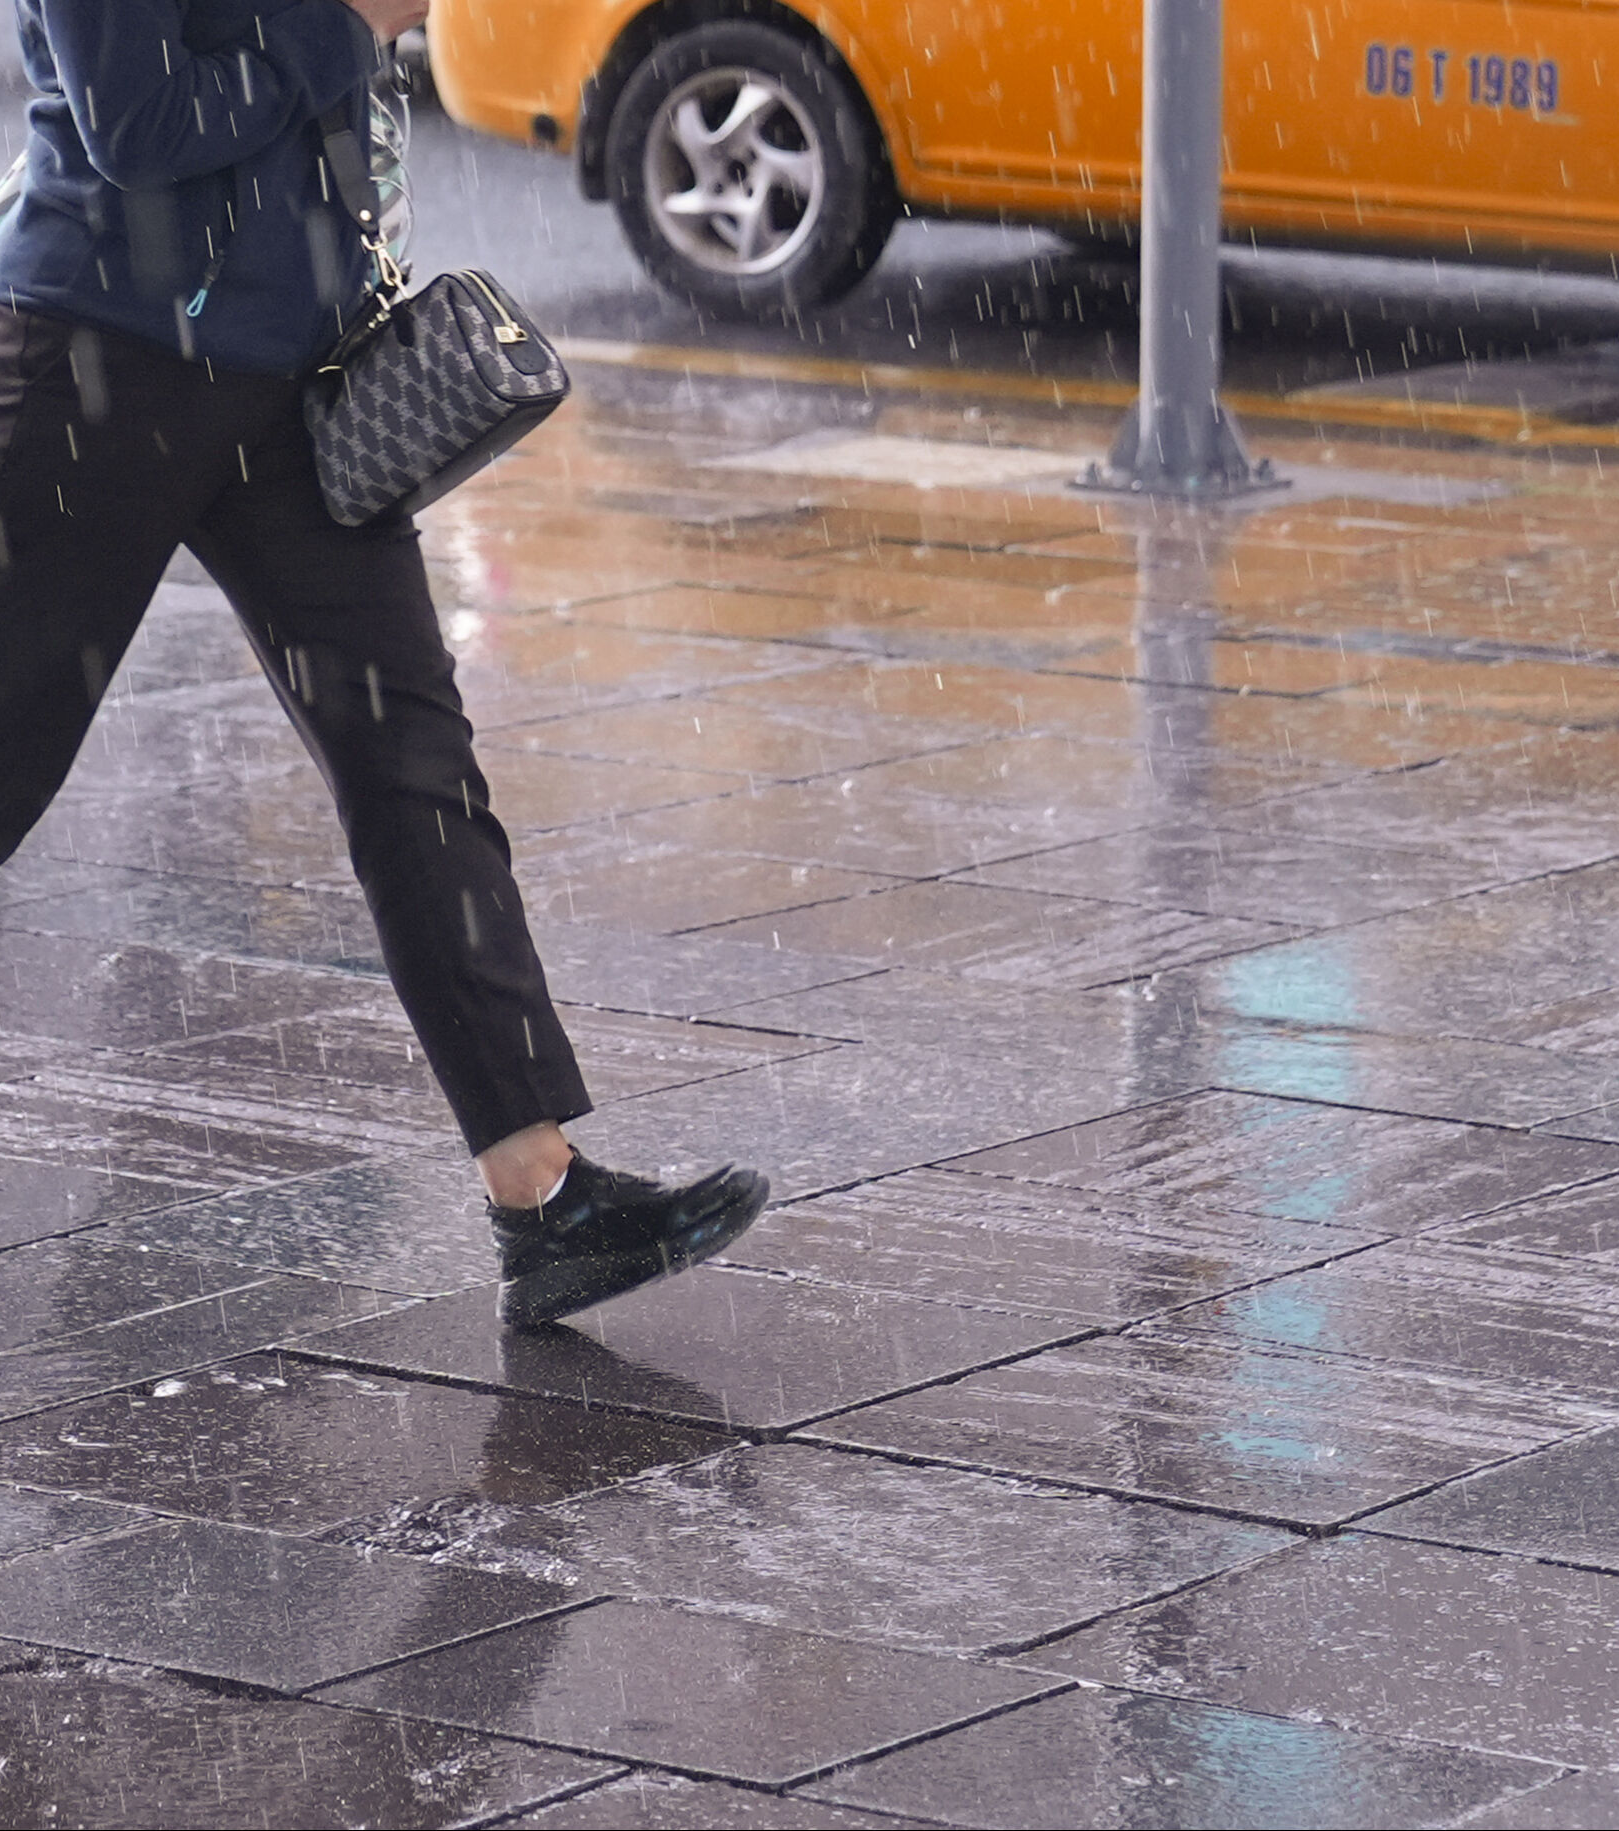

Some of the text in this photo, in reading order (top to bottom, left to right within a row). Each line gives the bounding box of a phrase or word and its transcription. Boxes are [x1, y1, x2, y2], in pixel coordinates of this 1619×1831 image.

[1366, 44, 1557, 112] 06 T 1989
